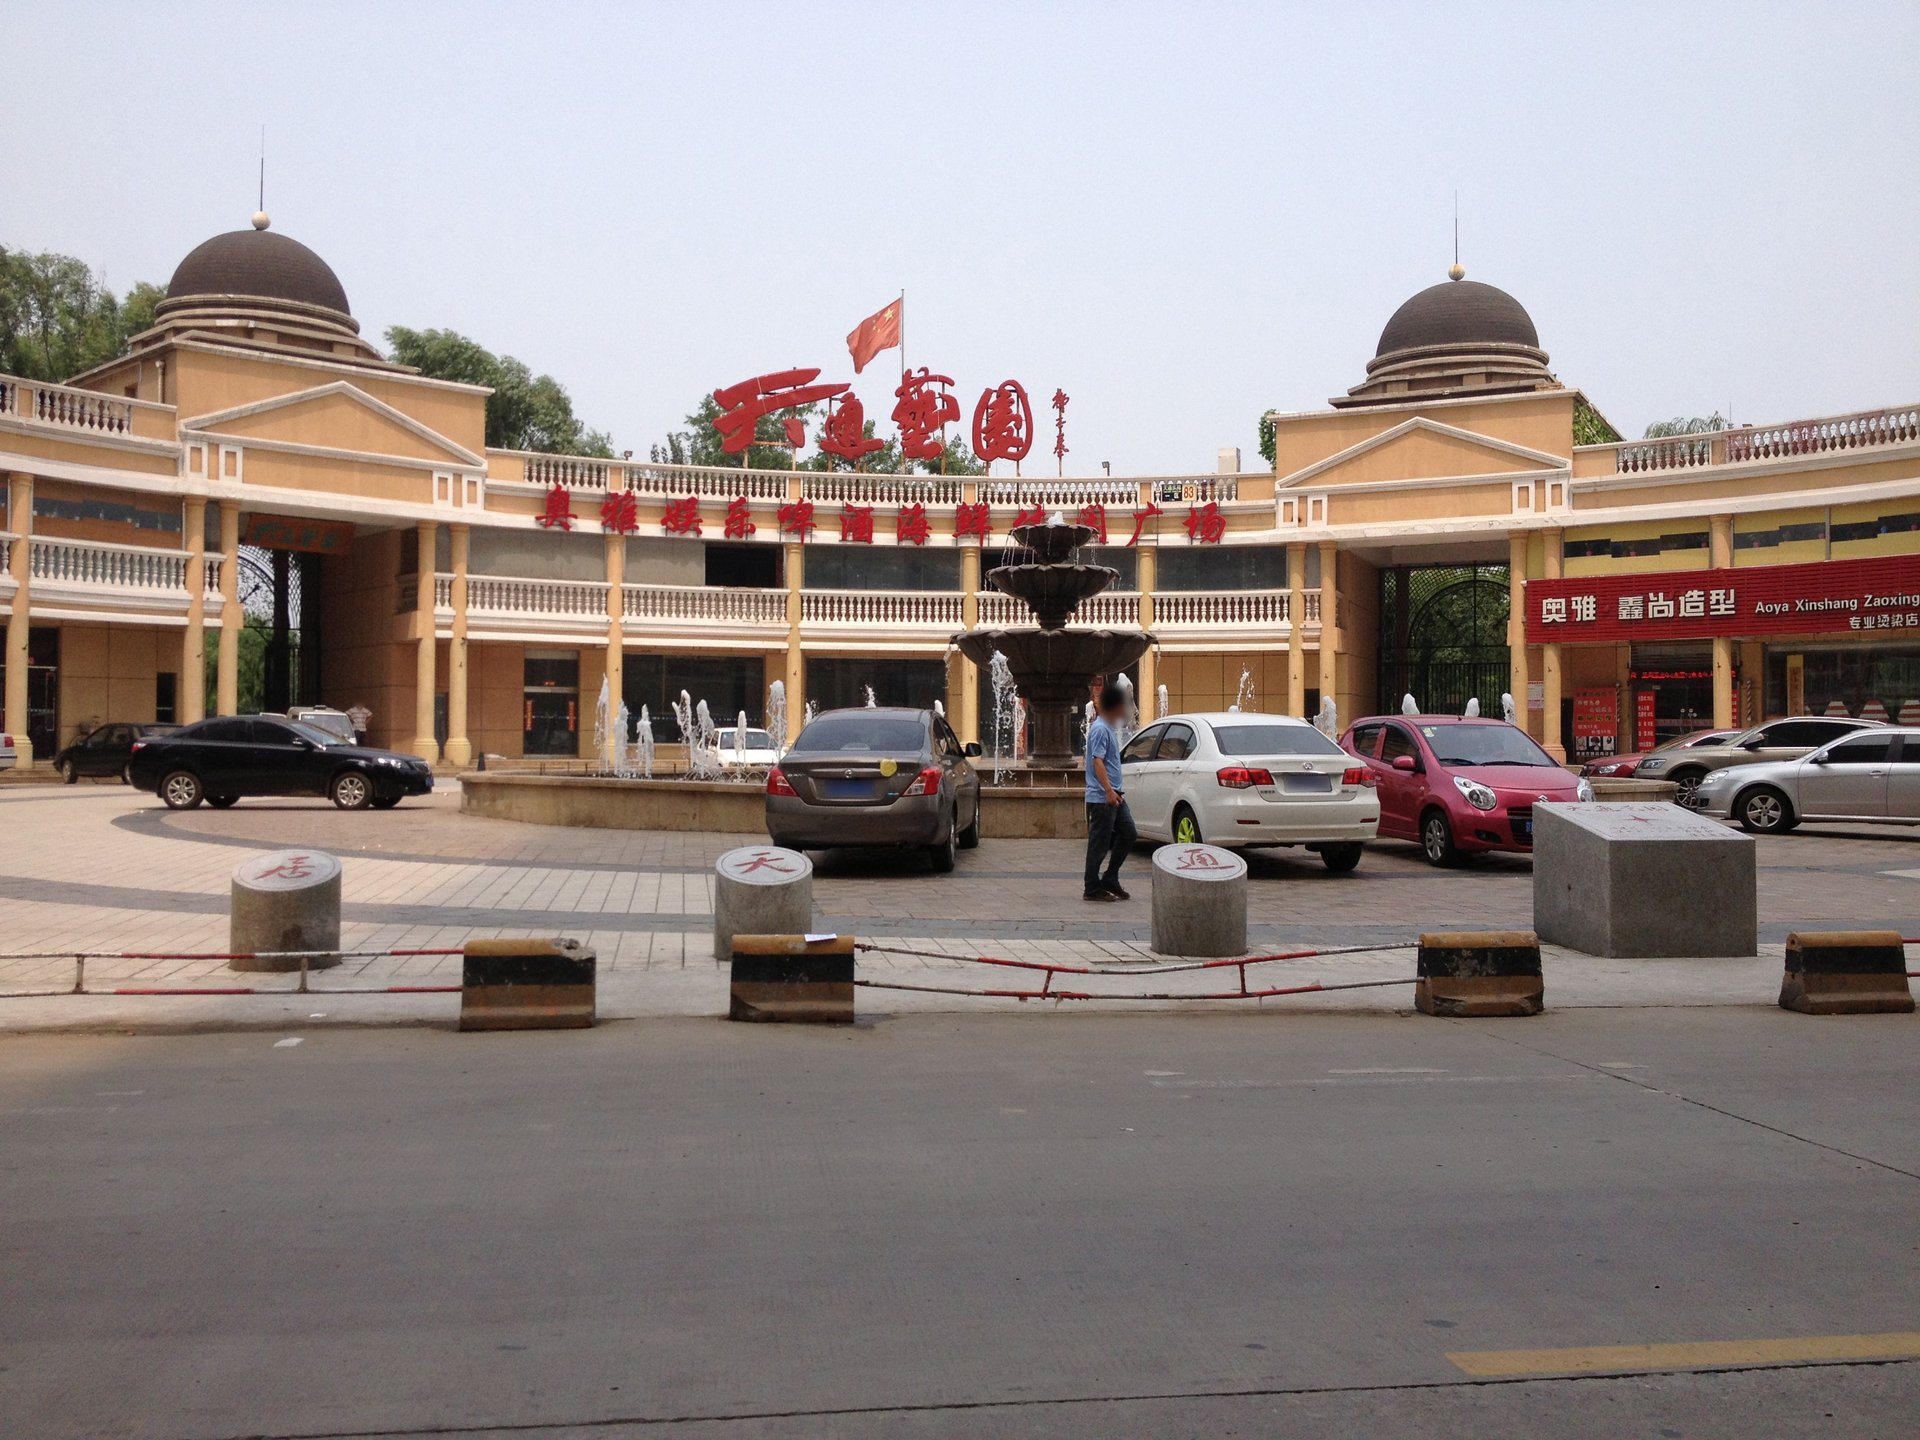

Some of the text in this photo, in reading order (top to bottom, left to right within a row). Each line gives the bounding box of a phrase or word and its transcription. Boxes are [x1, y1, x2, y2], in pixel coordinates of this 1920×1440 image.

[1183, 486, 1194, 499] 83
[1541, 588, 1737, 623] 奥雅 鑫尚造型
[1755, 593, 1920, 615] Aoya Xinshang Zaoxing
[1849, 613, 1919, 629] 专业烫染店
[733, 852, 798, 874] 天
